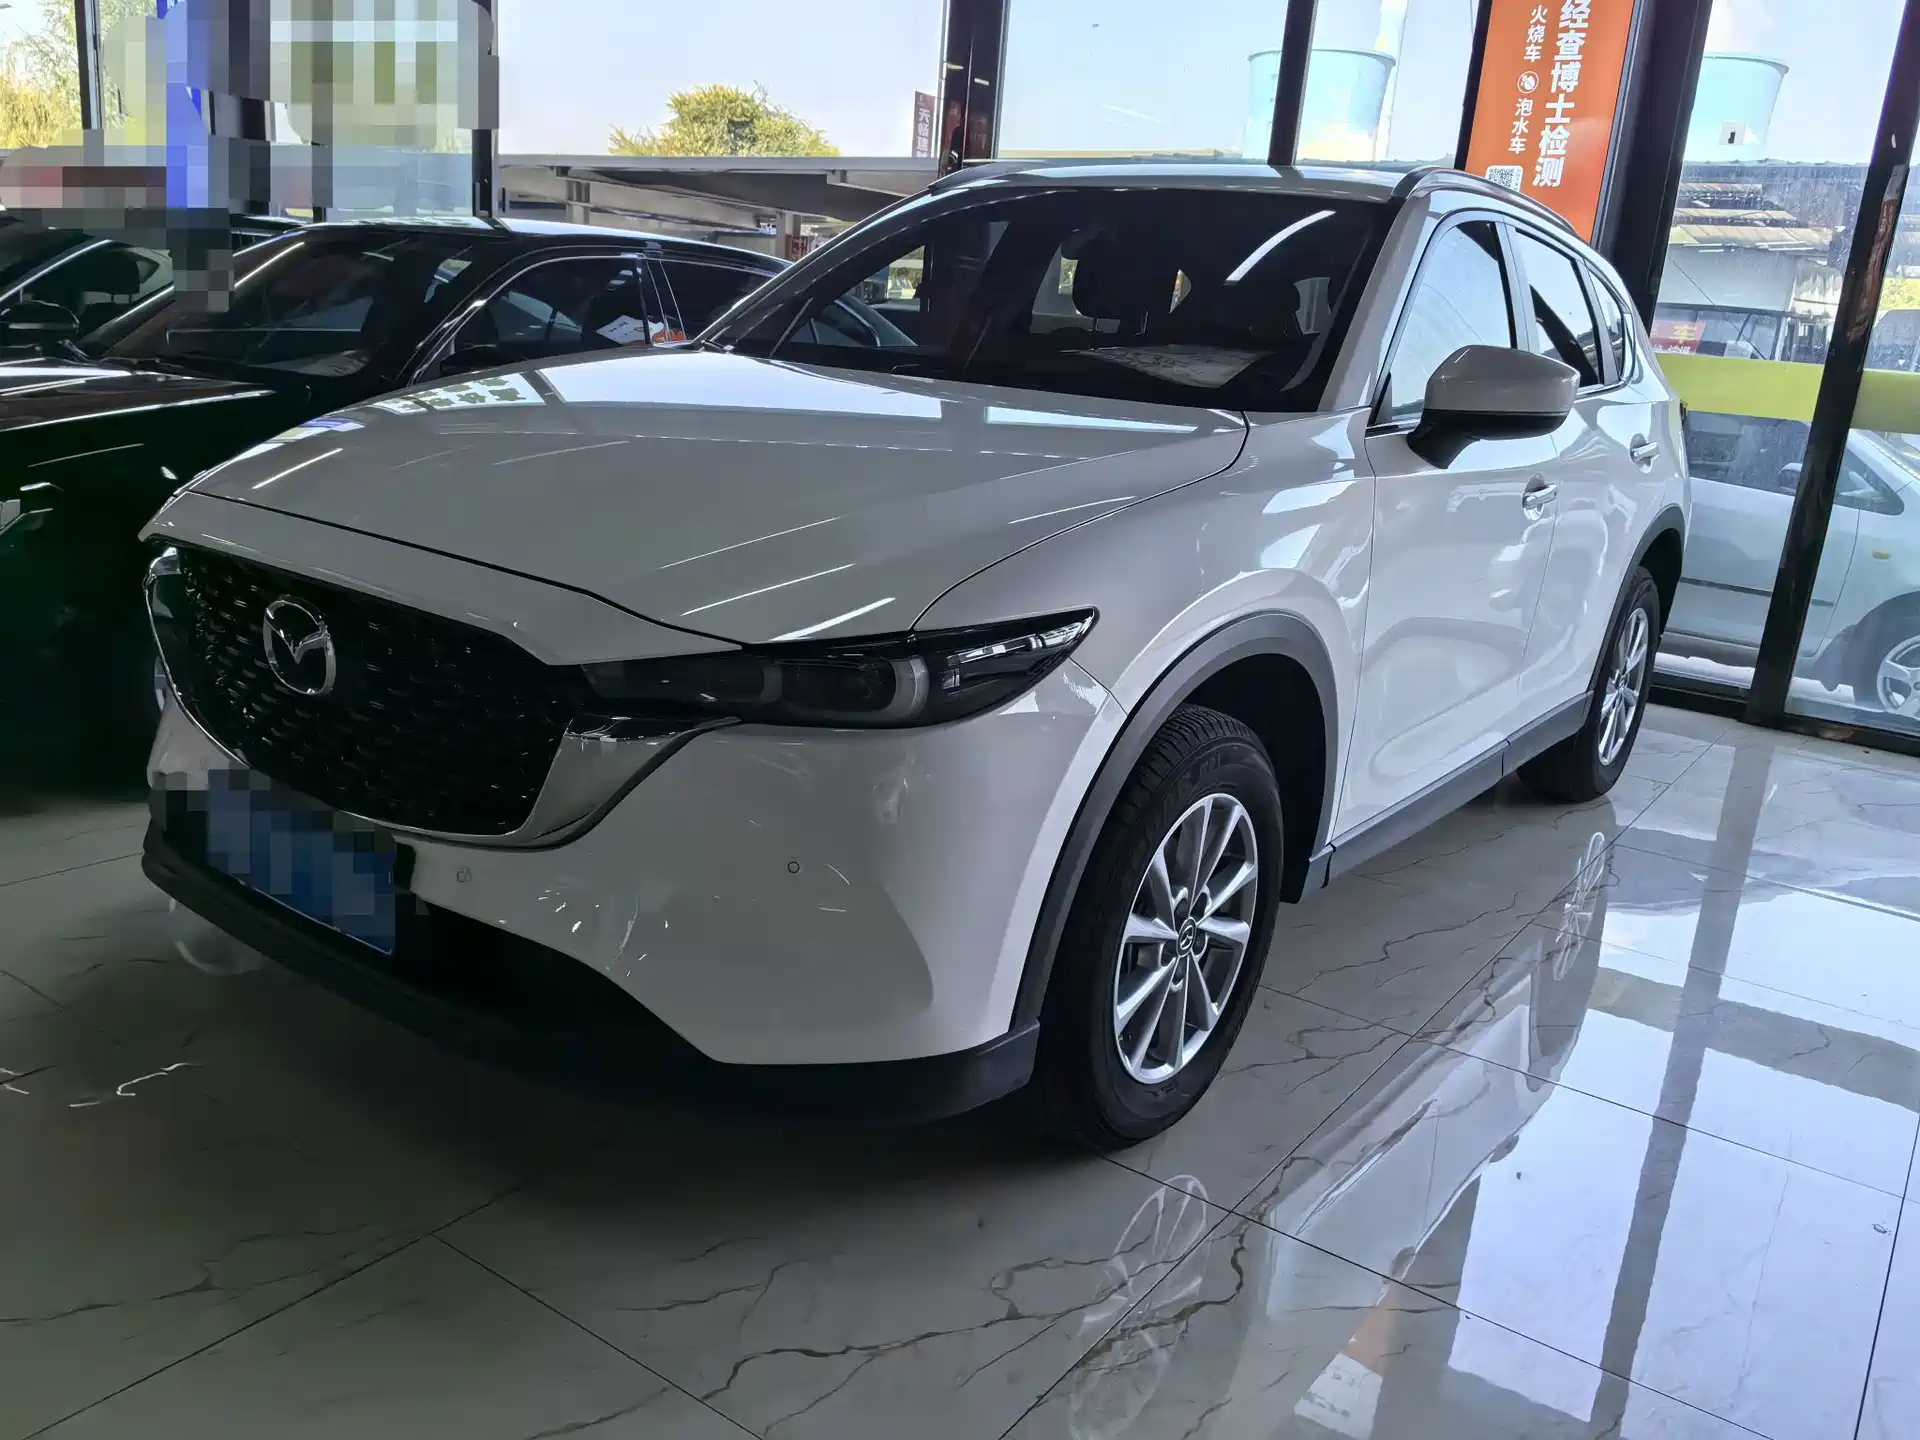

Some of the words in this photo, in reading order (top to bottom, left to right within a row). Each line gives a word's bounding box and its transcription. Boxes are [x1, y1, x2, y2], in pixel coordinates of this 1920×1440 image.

[1523, 4, 1549, 63] 火烧车
[1532, 0, 1591, 188] 经查博士检测
[1507, 97, 1534, 155] 泡水车
